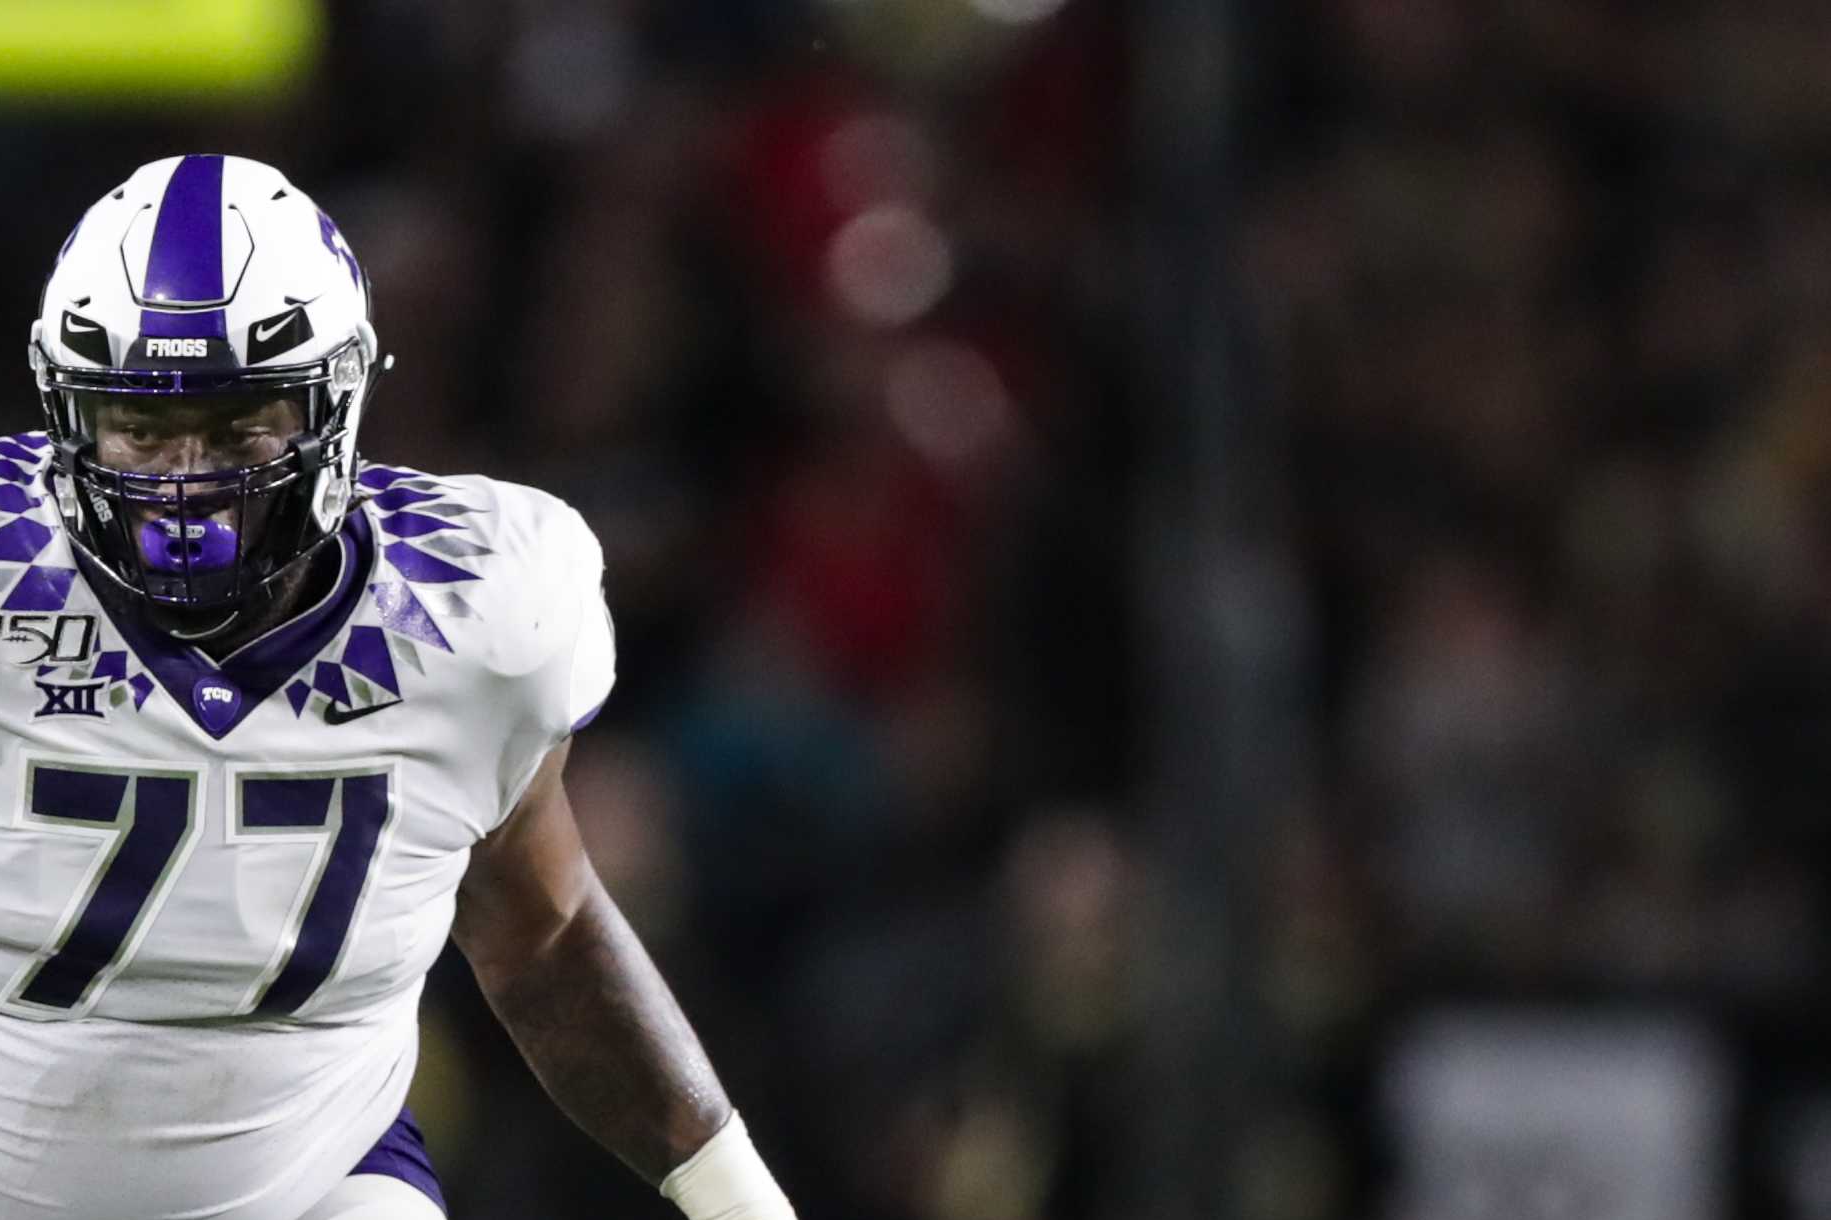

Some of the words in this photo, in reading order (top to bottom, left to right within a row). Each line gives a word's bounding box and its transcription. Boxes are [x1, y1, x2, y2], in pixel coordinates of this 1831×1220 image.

[146, 338, 207, 357] FROGS
[34, 680, 105, 718] XII
[201, 686, 233, 703] TCU
[8, 758, 398, 1020] 77
